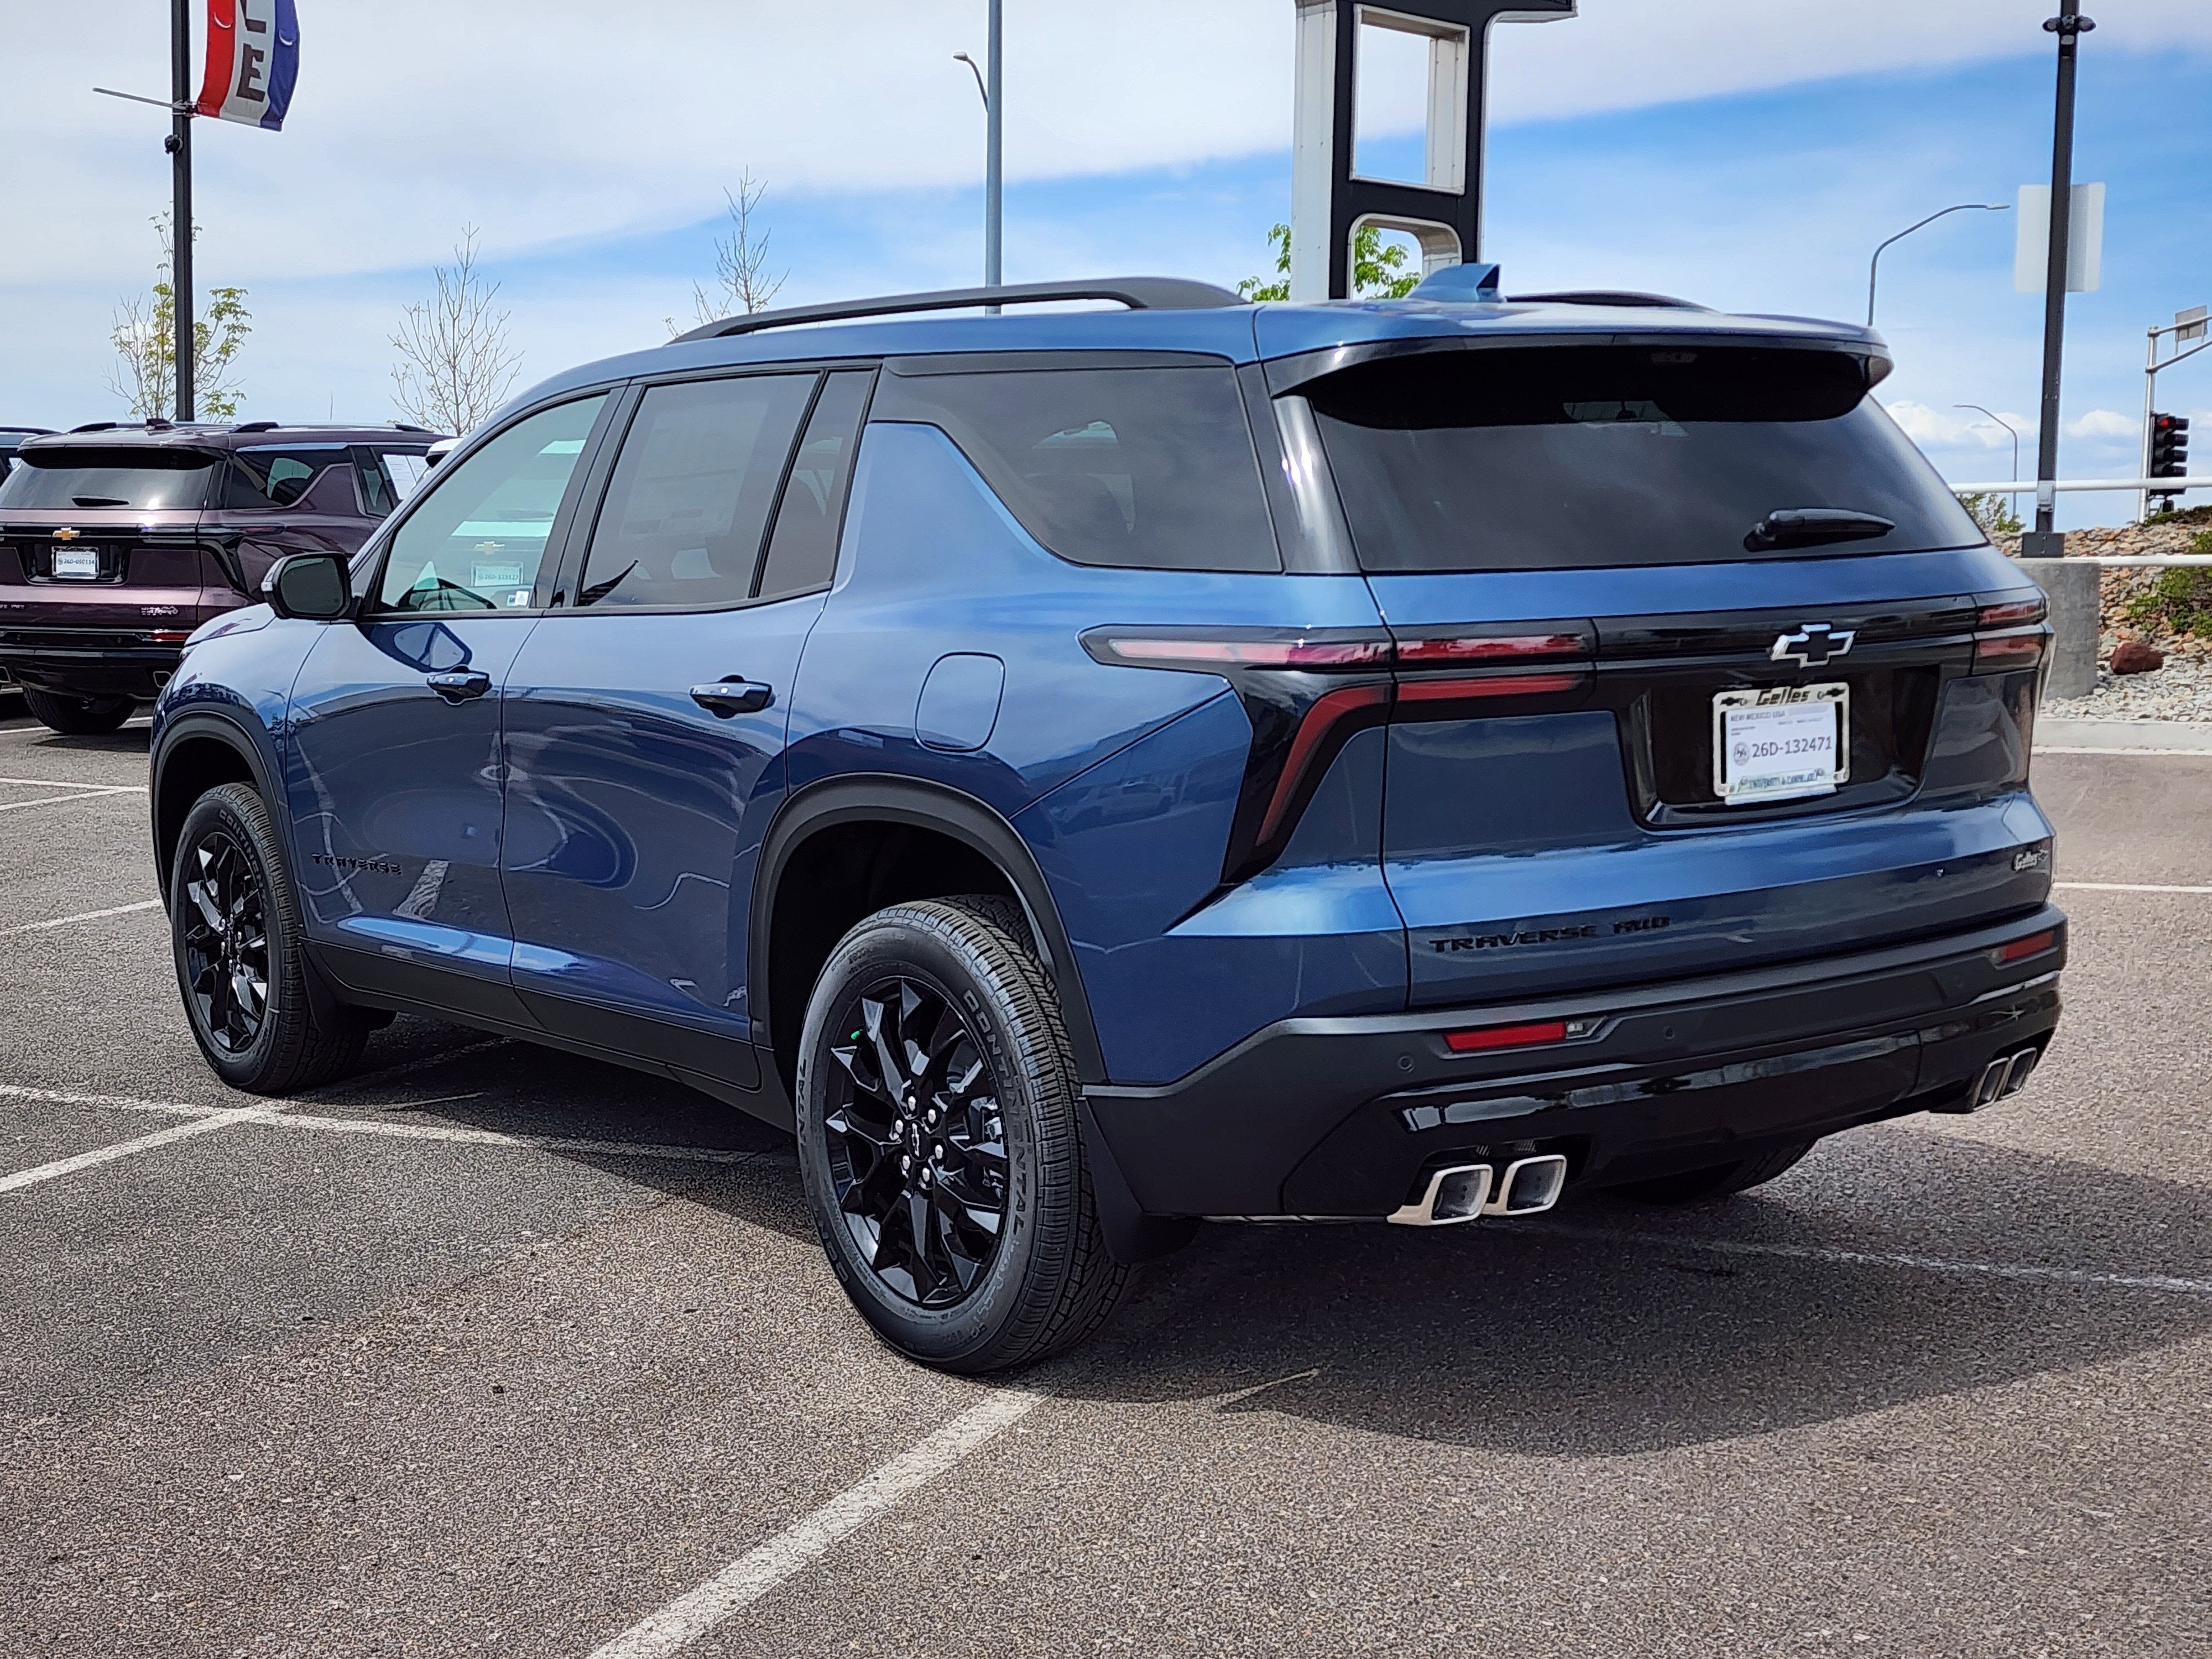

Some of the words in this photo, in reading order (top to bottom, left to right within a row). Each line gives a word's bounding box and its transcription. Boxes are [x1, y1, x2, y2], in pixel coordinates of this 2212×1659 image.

[1746, 712, 1771, 720] MEXICO
[1752, 735, 1832, 758] 26D-132471
[311, 852, 402, 875] TRAVERSE
[1428, 925, 1597, 953] TRAVERSE
